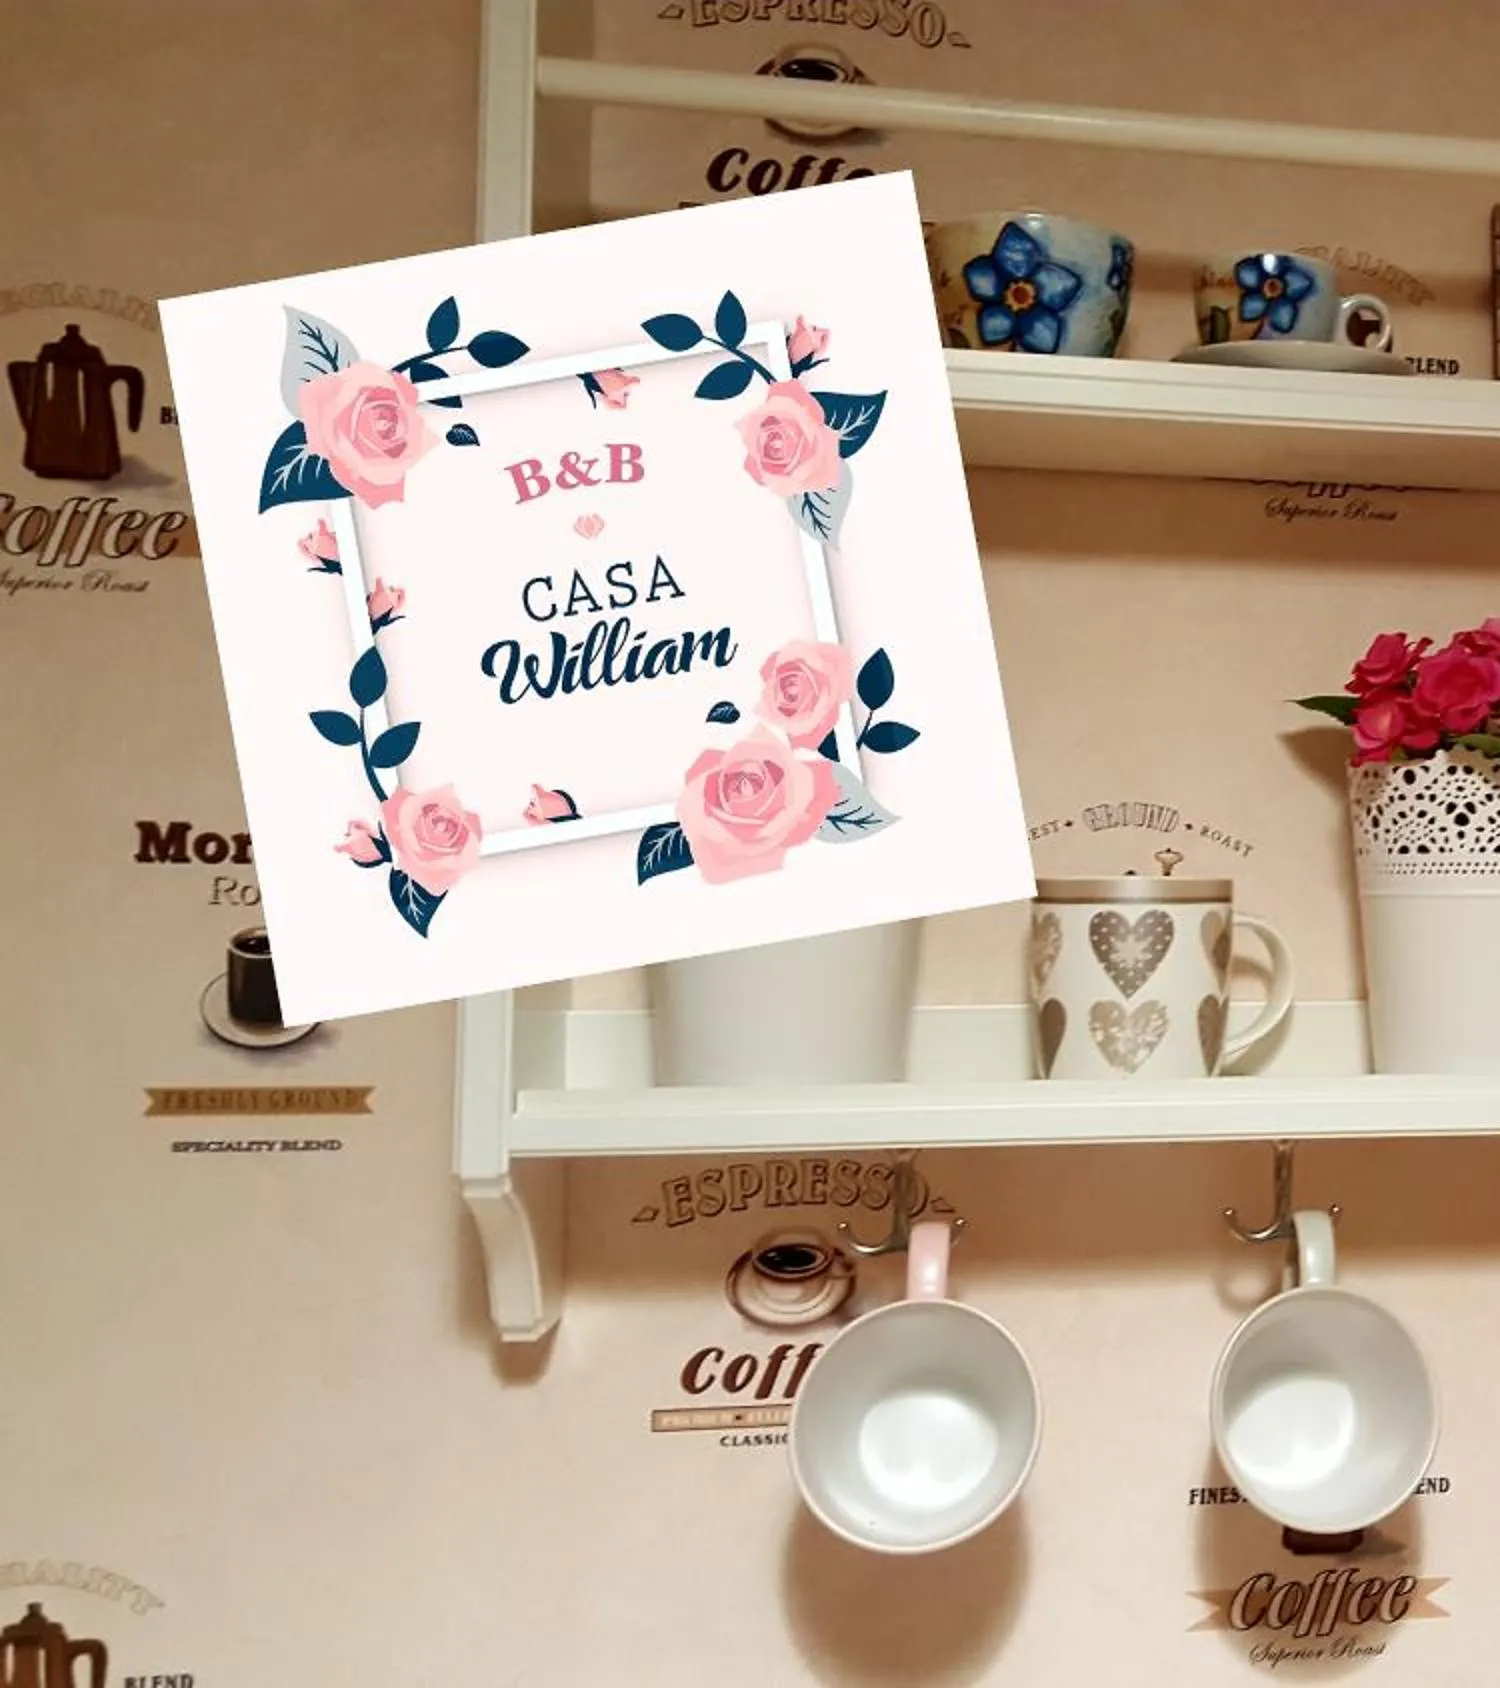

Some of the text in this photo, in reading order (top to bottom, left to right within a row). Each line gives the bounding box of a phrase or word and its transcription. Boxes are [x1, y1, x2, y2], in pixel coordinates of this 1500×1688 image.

[706, 147, 876, 197] Coff
[681, 1343, 825, 1401] Coff
[1188, 1477, 1451, 1506] FINES END
[1228, 1567, 1418, 1639] Coffee
